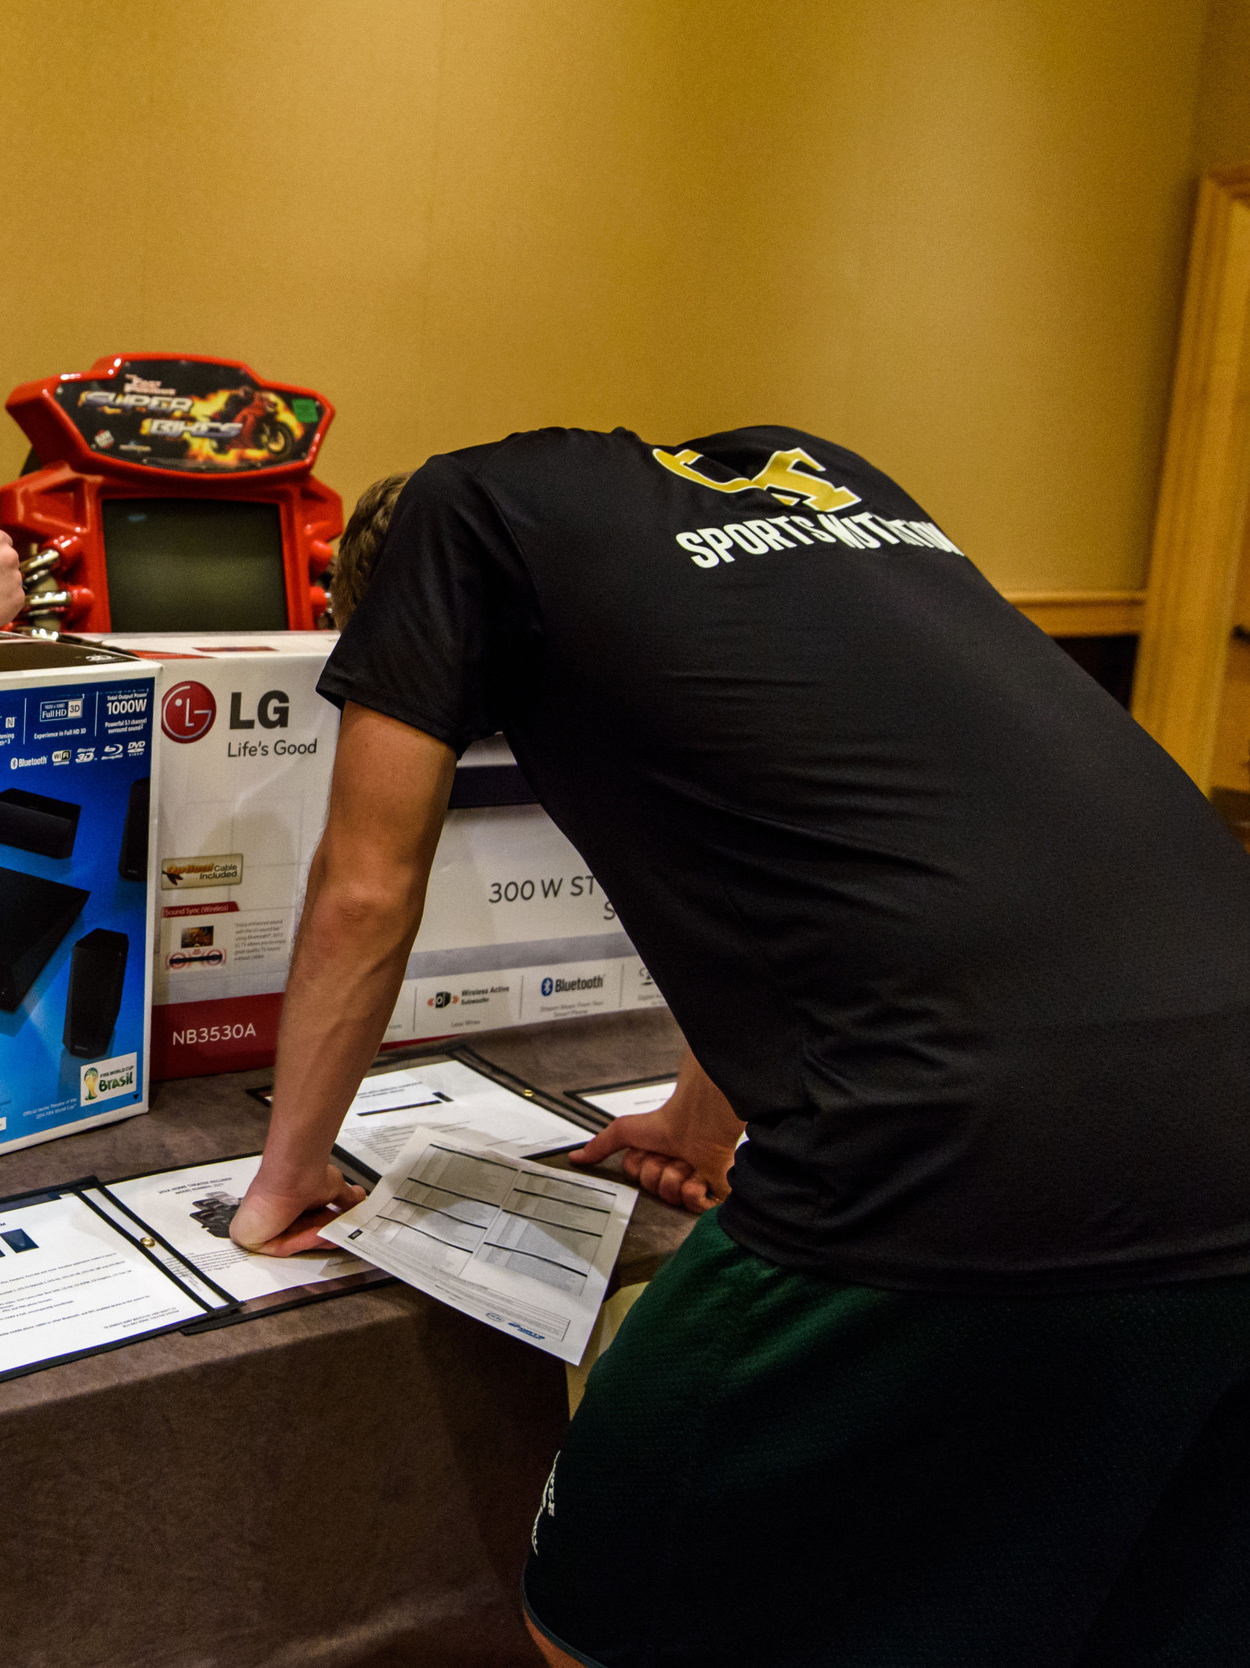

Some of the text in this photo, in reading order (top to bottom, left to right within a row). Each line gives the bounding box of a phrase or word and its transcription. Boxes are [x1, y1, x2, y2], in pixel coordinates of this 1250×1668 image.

[675, 515, 837, 568] SPORTS
[41, 708, 67, 719] Full HD
[69, 704, 81, 713] 3D
[106, 698, 148, 715] 1000W
[229, 690, 290, 730] LG
[33, 732, 58, 740] Experience
[227, 738, 318, 758] Life's Good
[18, 754, 48, 768] Bluetooth
[213, 863, 237, 873] Cable
[488, 880, 536, 904] 300
[540, 877, 564, 899] W
[461, 985, 510, 997] Wireless Active
[554, 975, 604, 994] Bluetooth
[172, 1022, 257, 1046] NB3530A
[98, 1072, 134, 1092] Brasil
